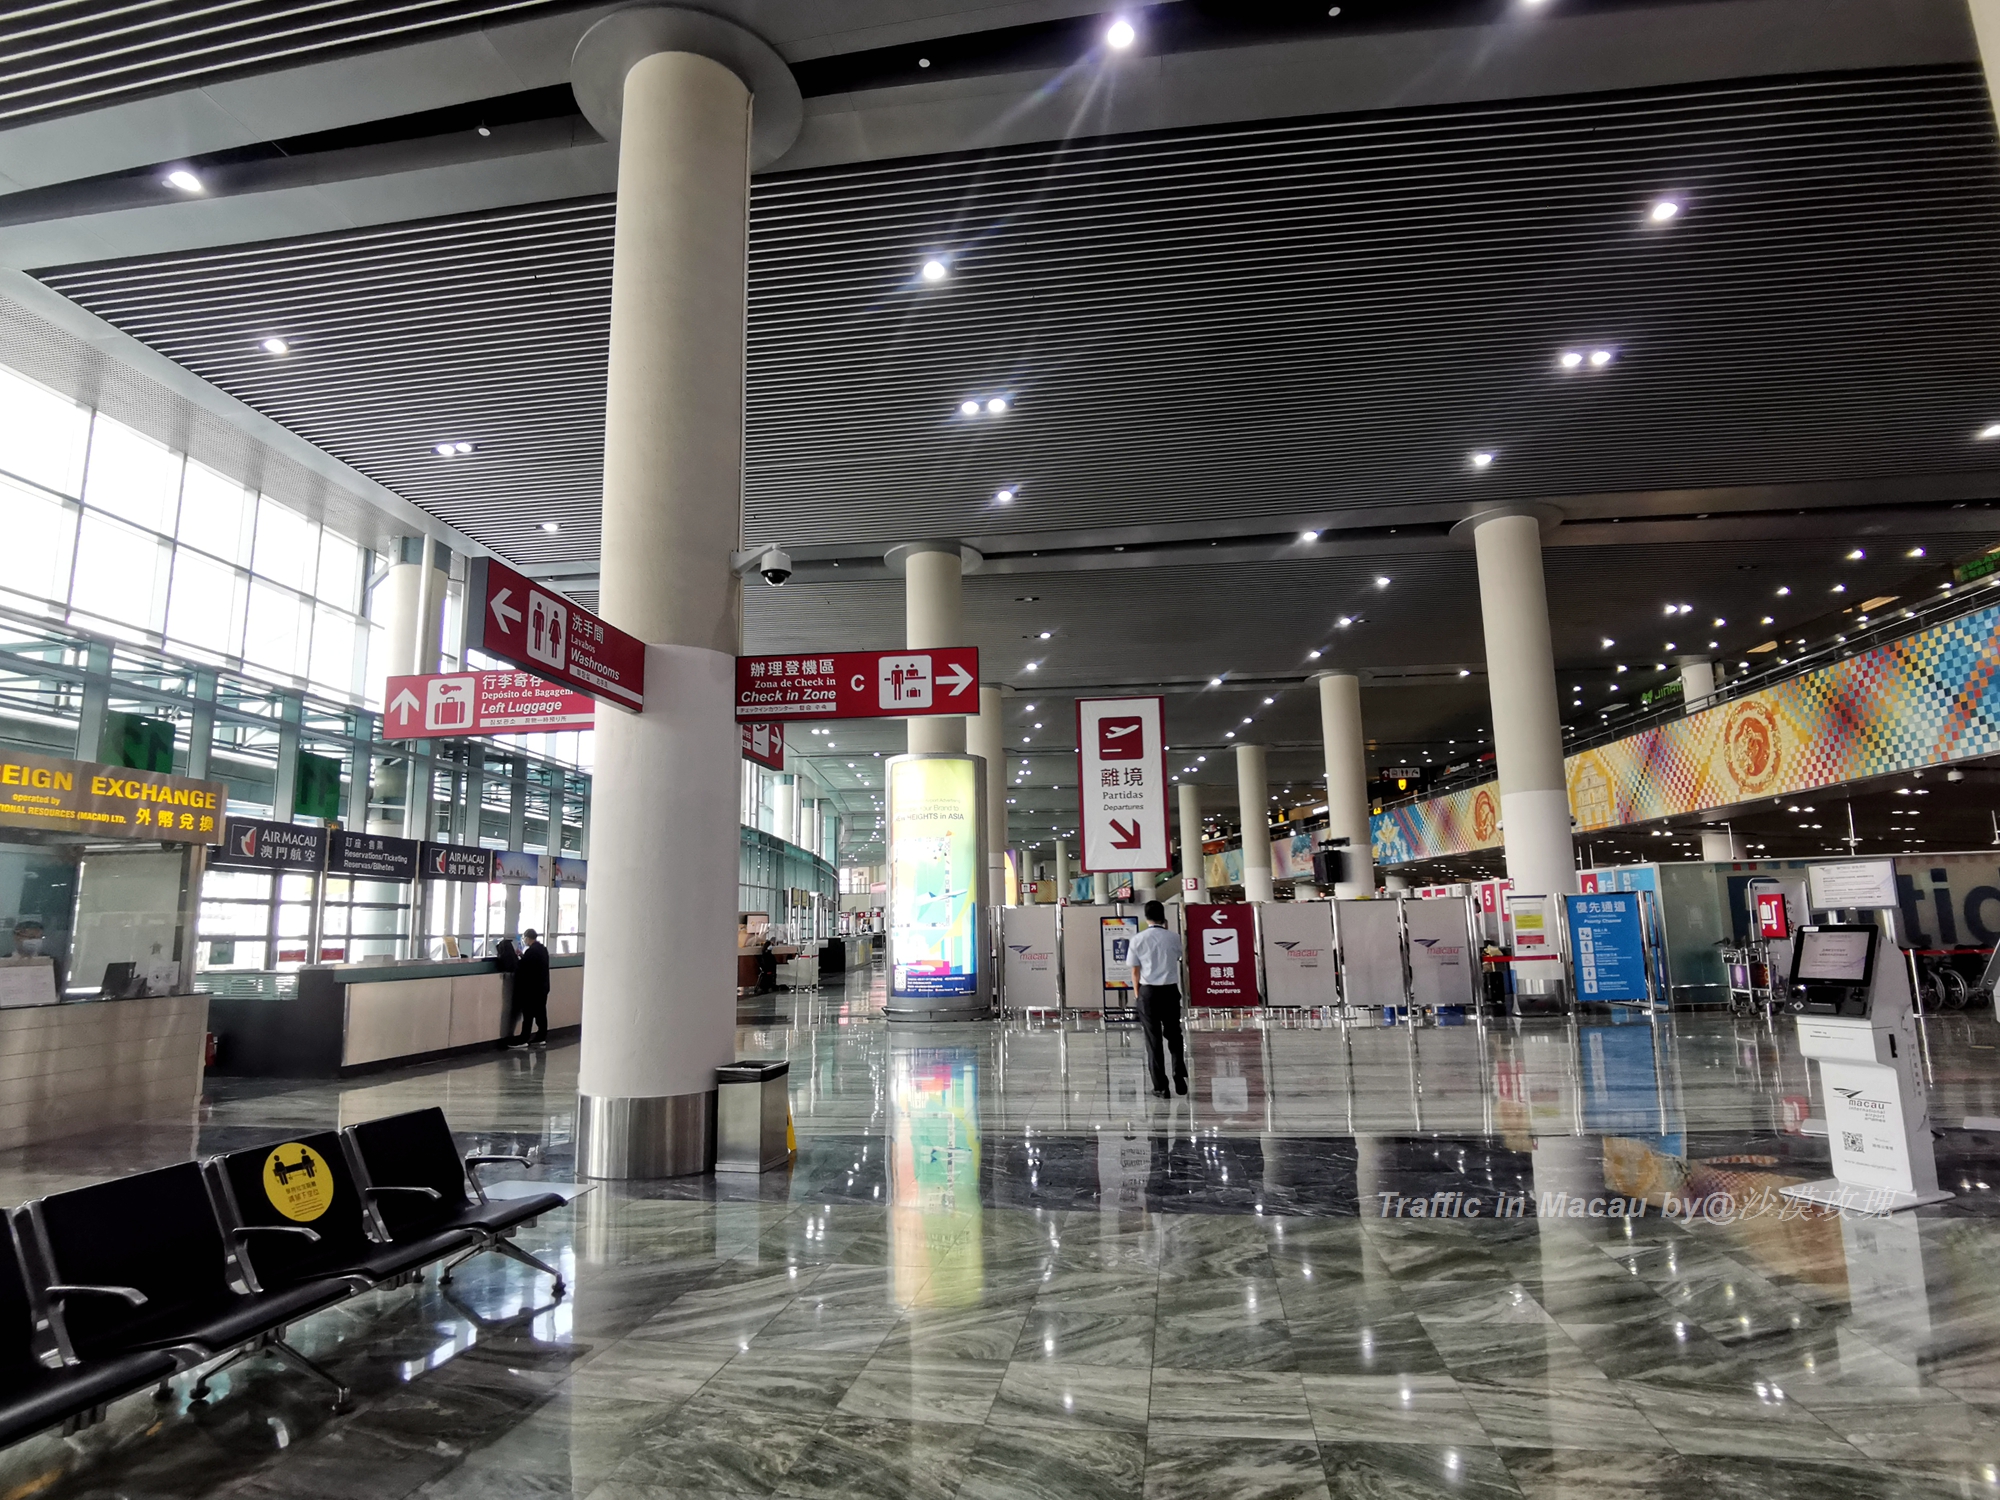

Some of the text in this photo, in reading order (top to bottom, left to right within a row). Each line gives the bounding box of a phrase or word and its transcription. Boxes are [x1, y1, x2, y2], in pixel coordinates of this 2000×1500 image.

[572, 612, 604, 644] 洗手間
[571, 634, 596, 653] Lavabos
[571, 647, 620, 680] Washrooms
[750, 659, 834, 677] 辦理登機區
[755, 677, 836, 688] Zona de Check in
[851, 674, 865, 691] C
[482, 690, 519, 701] Depósito
[522, 689, 532, 698] de
[741, 689, 836, 703] Check in Zone
[481, 700, 562, 715] Left Luggage
[1100, 767, 1143, 787] 離境
[0, 764, 217, 809] EIGN EXCHANGE
[12, 793, 61, 806] operated by
[1102, 790, 1143, 800] Partidas
[28, 806, 75, 819] RESOURCES
[77, 811, 109, 823] (MACAU)
[111, 815, 127, 824] LTD.
[136, 808, 214, 832] 外幣兌換
[907, 812, 939, 820] HEIGHTS
[940, 812, 947, 820] in
[948, 813, 964, 821] ASIA
[260, 845, 316, 862] 澳門航空
[344, 849, 408, 865] Reservations/Ticketing
[448, 863, 485, 876] 澳門航空
[1485, 890, 1491, 906] 5
[1576, 901, 1626, 913] 優先通道
[1428, 947, 1459, 955] macau
[1210, 966, 1235, 978] 離境
[1849, 1099, 1885, 1110] macau
